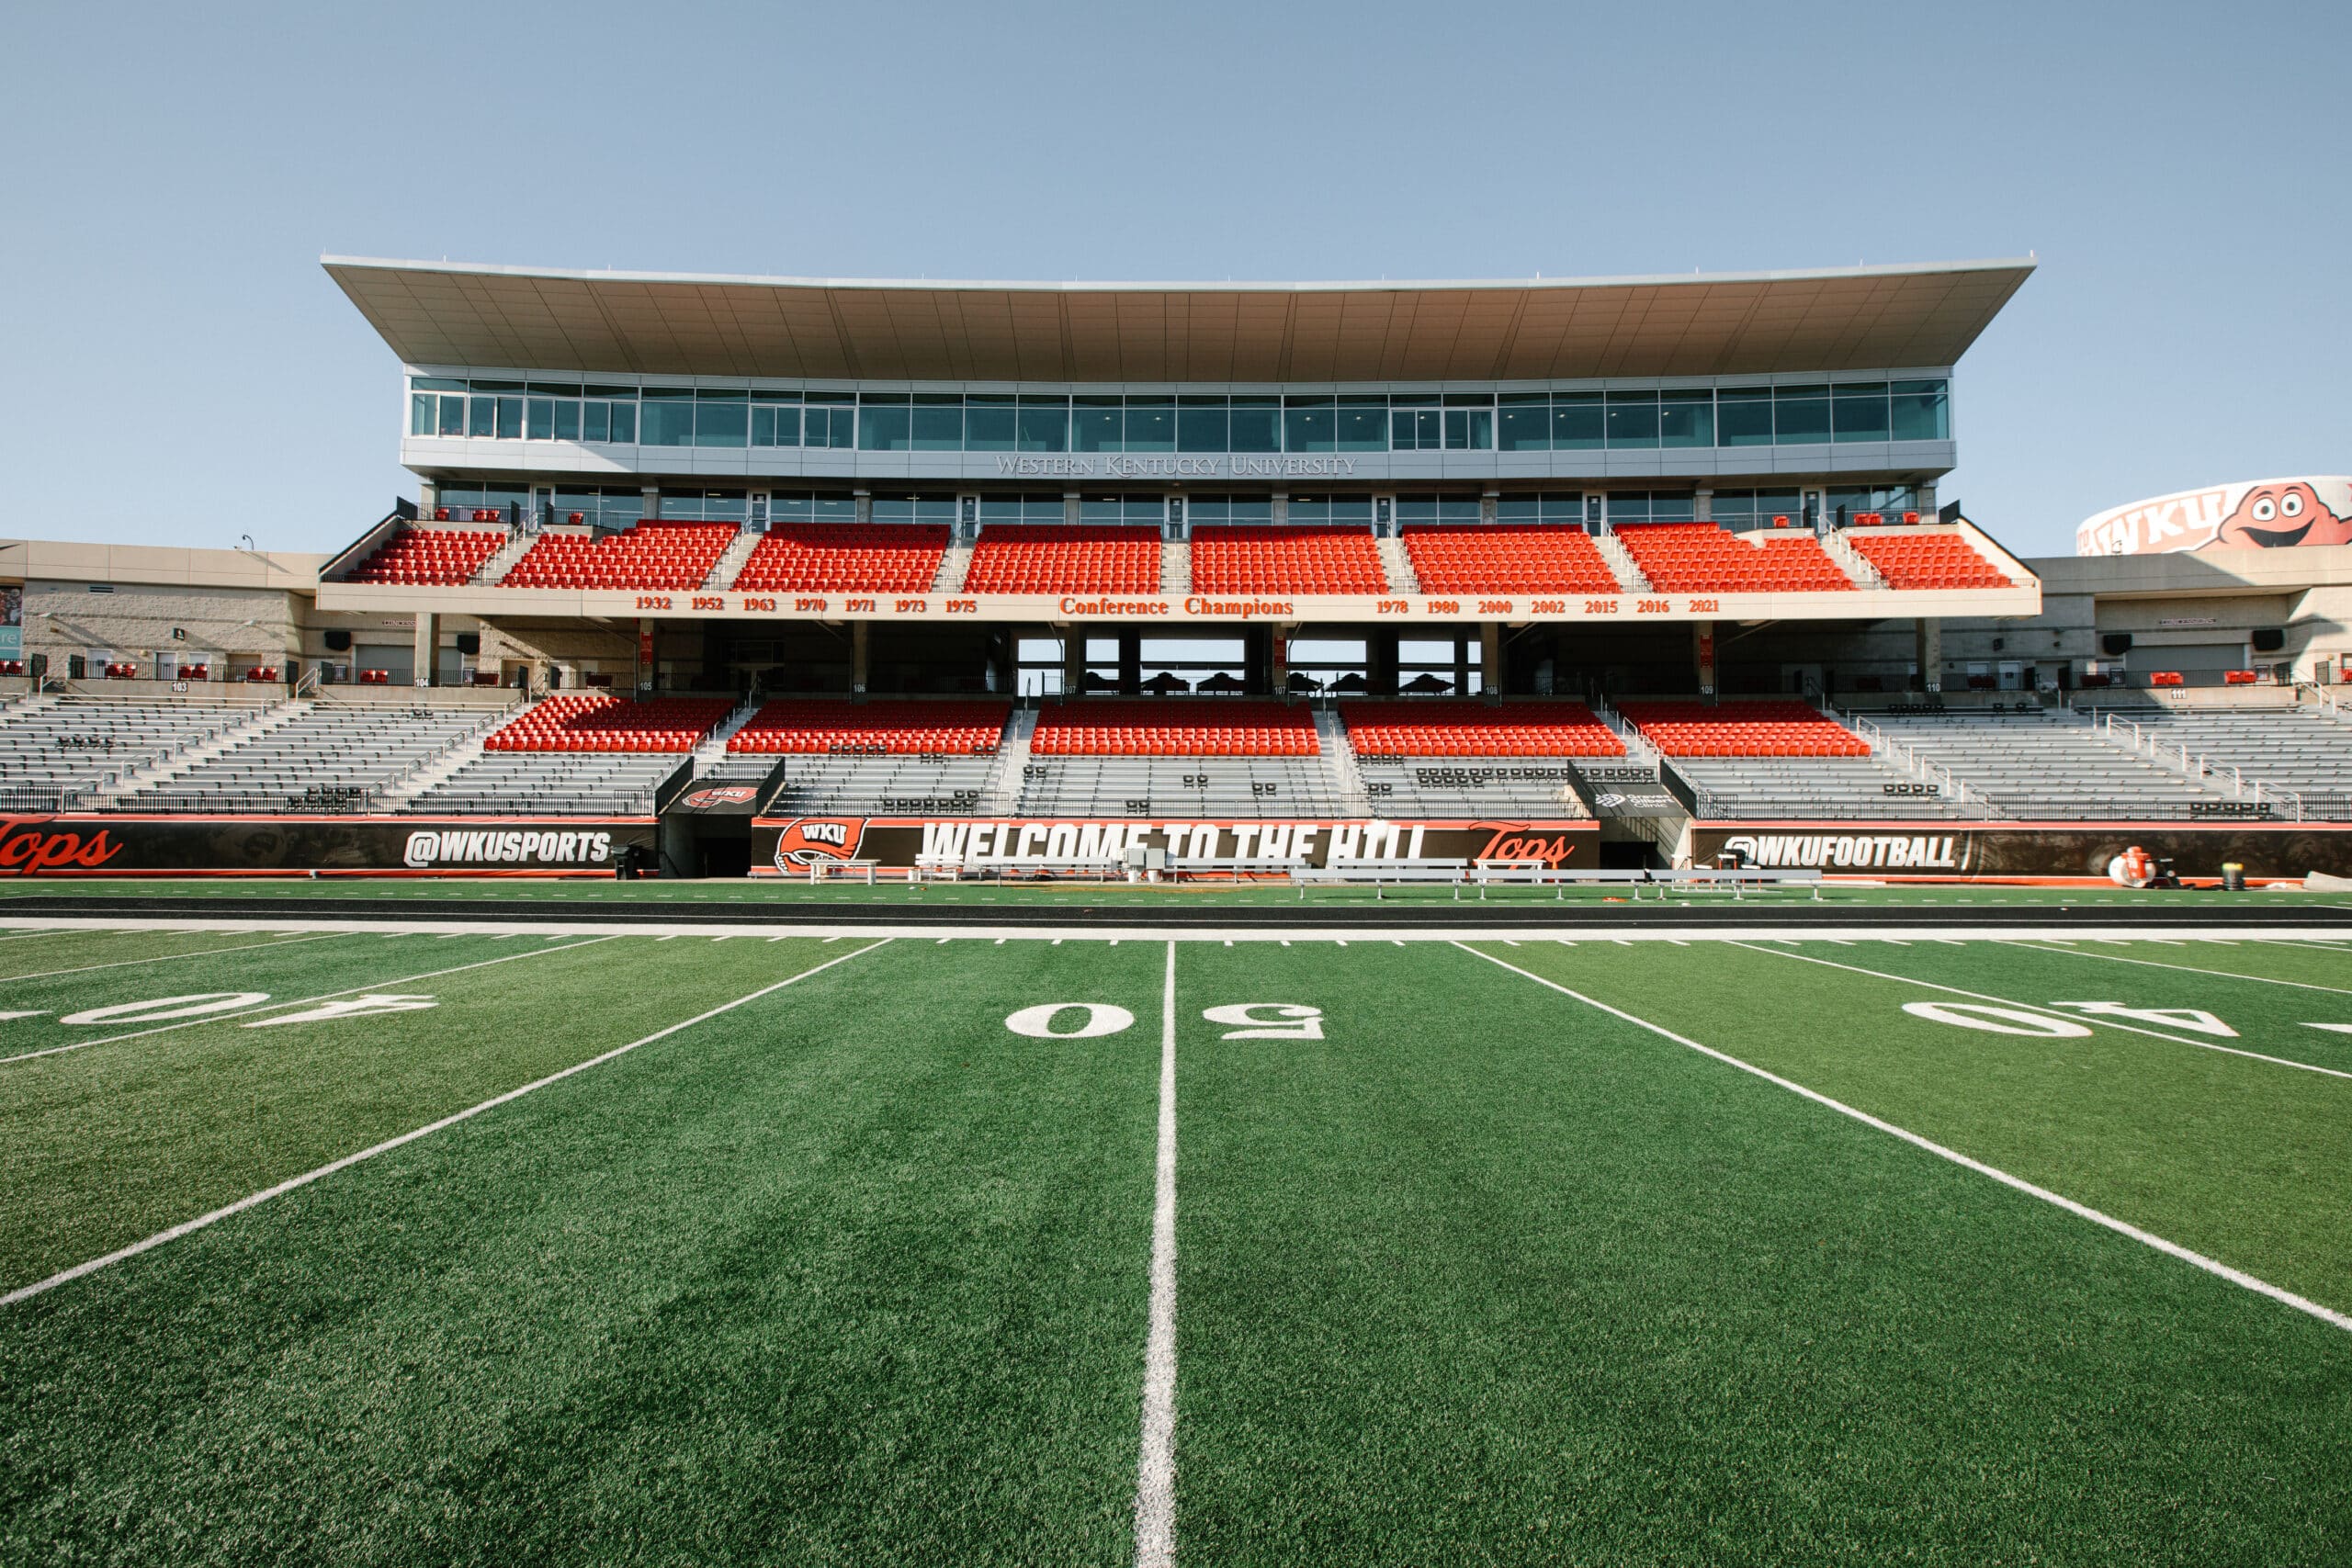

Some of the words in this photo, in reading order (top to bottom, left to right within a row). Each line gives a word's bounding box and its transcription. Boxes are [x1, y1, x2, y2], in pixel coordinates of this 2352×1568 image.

[2096, 492, 2222, 555] WKU
[635, 596, 672, 611] 1932
[691, 596, 724, 611] 1952
[743, 597, 775, 612] 1963
[794, 598, 826, 613] 1970
[844, 599, 876, 613] 1971
[894, 599, 926, 613] 1973
[944, 600, 977, 614] 1975
[1059, 597, 1169, 615] Conference
[1184, 597, 1294, 619] Champions
[1376, 600, 1408, 614] 1978
[1427, 600, 1459, 614] 1980
[1478, 600, 1512, 614] 2000
[1531, 600, 1566, 614] 2002
[1585, 600, 1618, 614] 2015
[1637, 599, 1669, 613] 2016
[1689, 599, 1719, 613] 2021
[173, 682, 187, 692] 103
[415, 679, 428, 687] 104
[640, 682, 652, 691] 105
[854, 683, 865, 693] 106
[1927, 683, 1940, 692] 110
[1274, 686, 1286, 694] 107
[1701, 685, 1713, 694] 109
[2171, 689, 2187, 698] 111
[800, 823, 847, 846] WKU
[403, 831, 611, 867] @WKUSPORTS
[922, 823, 1152, 871] WELCOME
[1163, 824, 1220, 871] TO
[1232, 824, 1317, 871] THE
[1328, 824, 1425, 869] HILL
[1470, 820, 1575, 870] Tops
[1724, 836, 1955, 867] @WKUFOOTBALL
